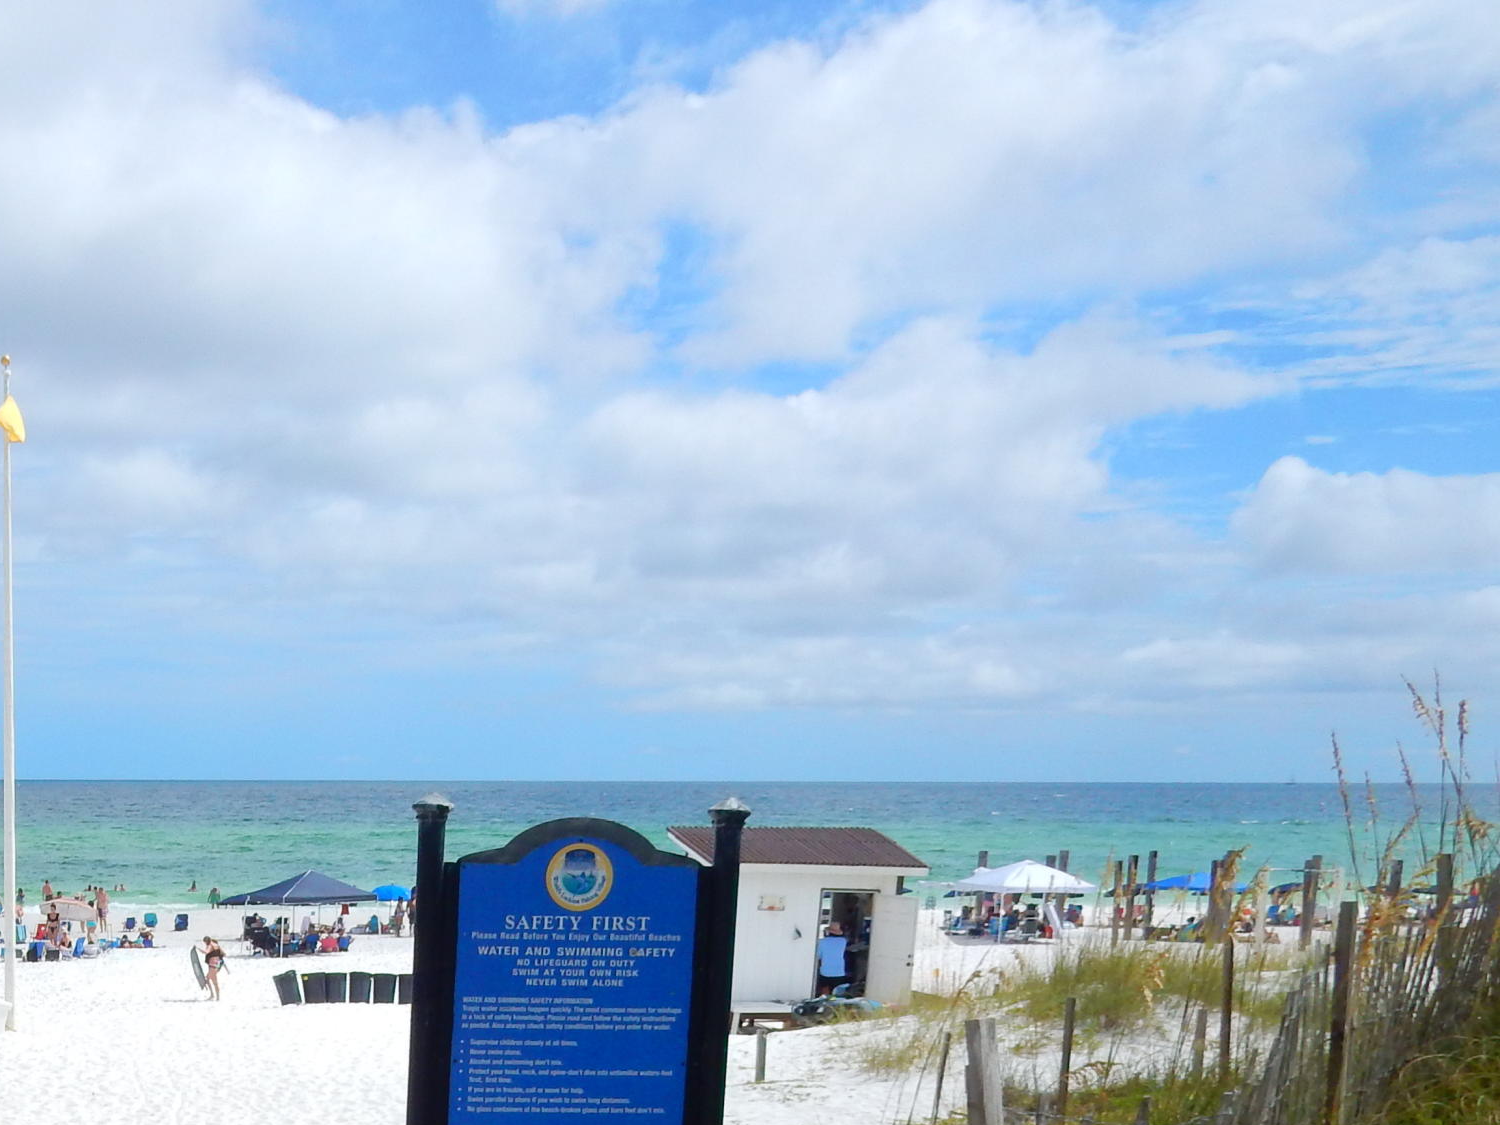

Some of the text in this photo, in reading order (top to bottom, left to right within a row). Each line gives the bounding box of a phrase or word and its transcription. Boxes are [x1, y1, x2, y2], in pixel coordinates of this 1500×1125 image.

[505, 916, 650, 930] SAFETY FIRST
[477, 946, 675, 956] WATER AND SWIMMING SAFETY
